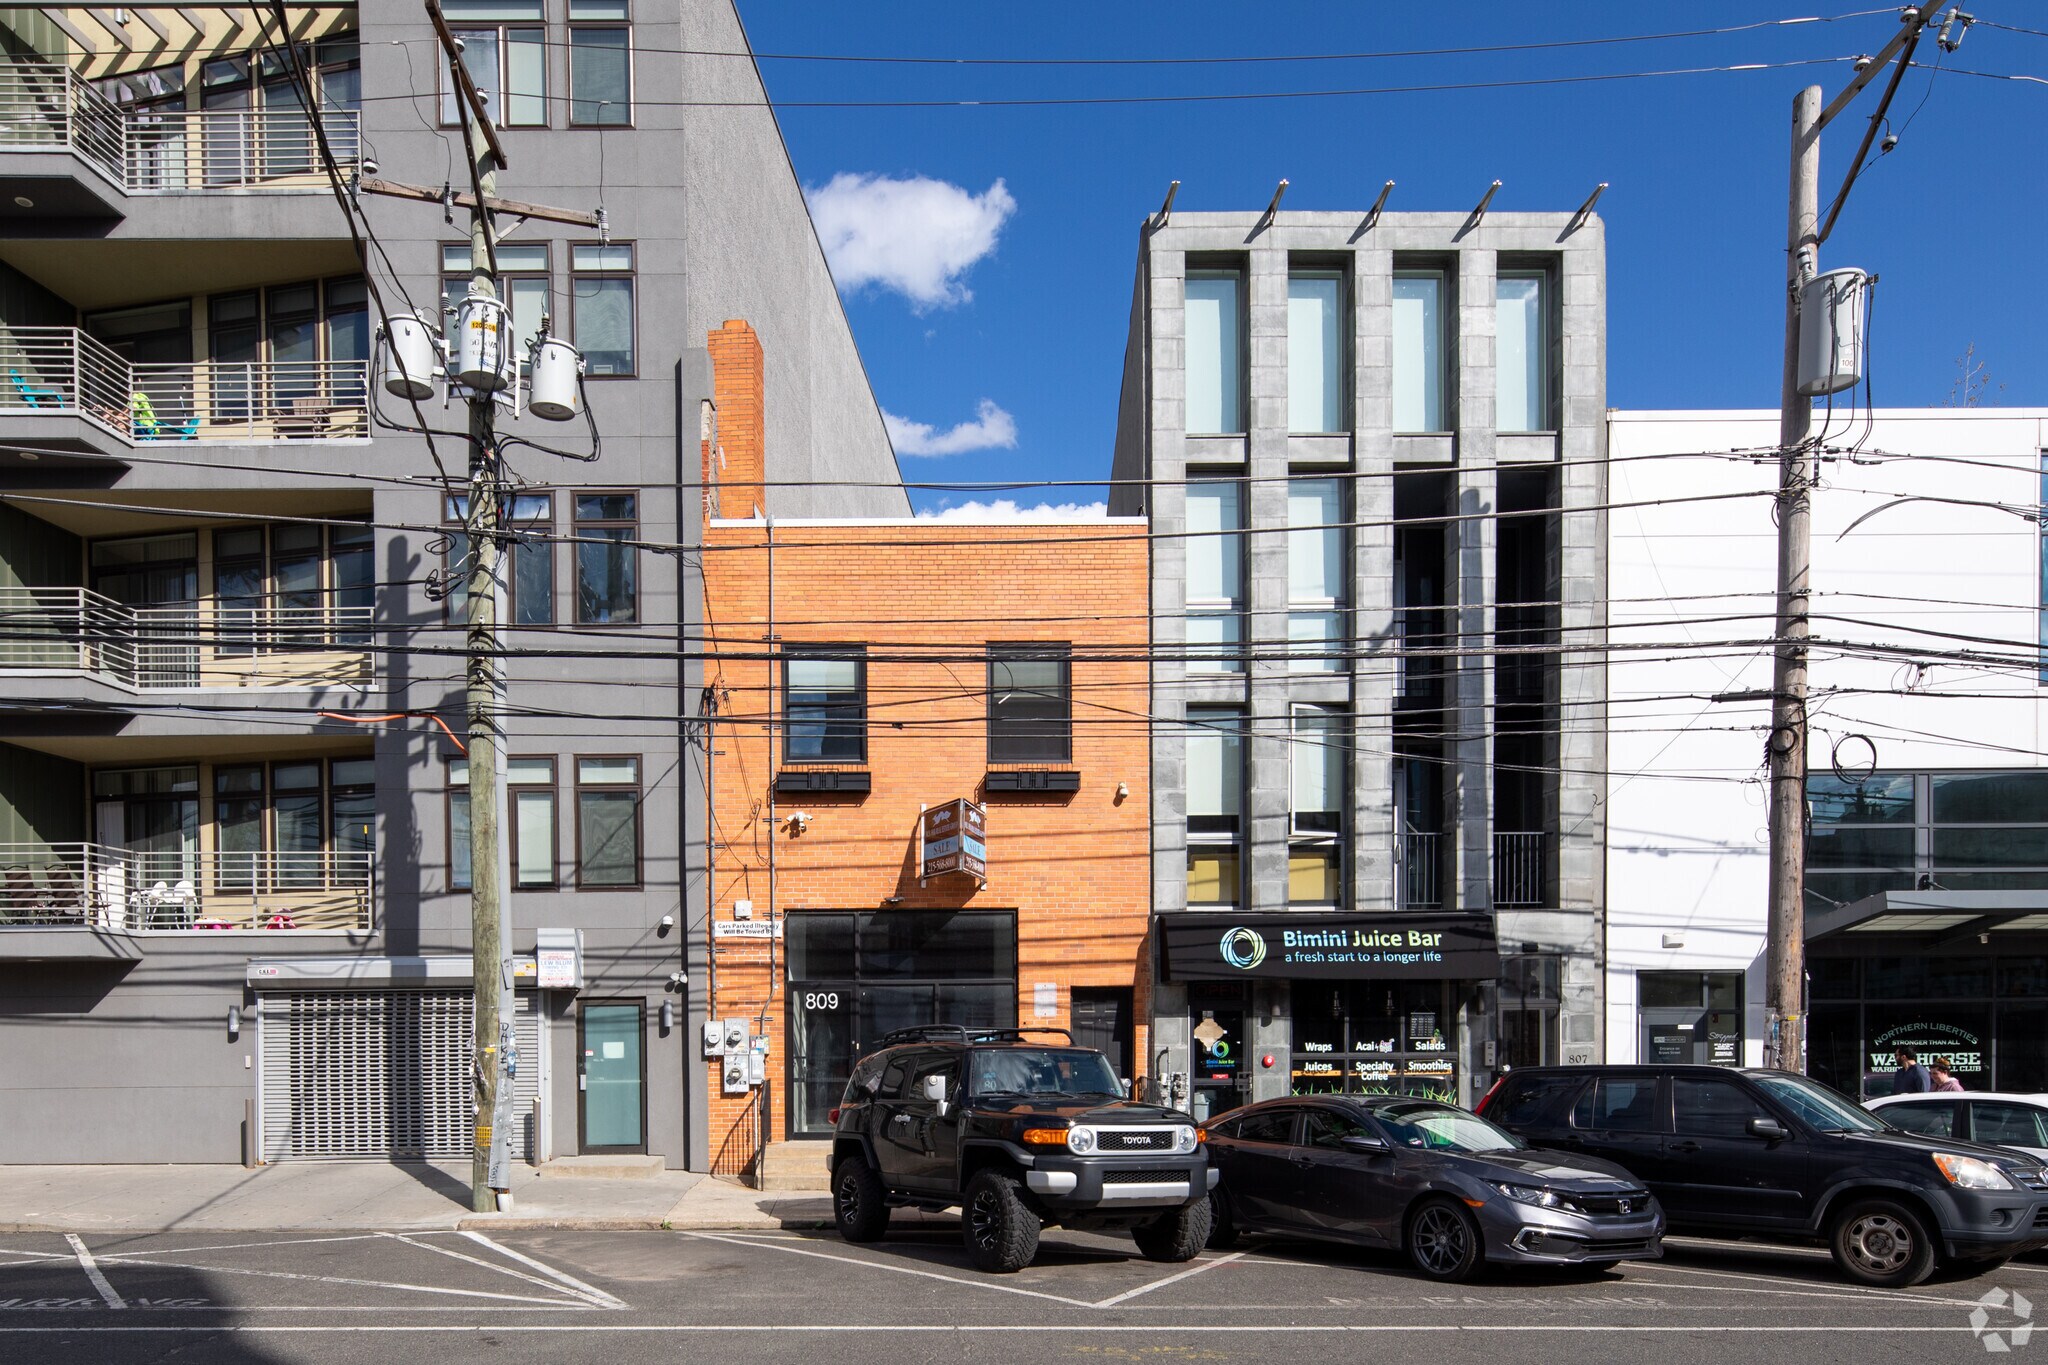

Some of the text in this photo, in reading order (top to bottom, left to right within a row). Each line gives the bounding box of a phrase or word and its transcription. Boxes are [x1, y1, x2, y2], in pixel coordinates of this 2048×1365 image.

[933, 841, 951, 855] SALE
[1283, 930, 1442, 947] Bimini Juice Bar
[1285, 951, 1442, 964] a fresh start to a longer life
[805, 992, 839, 1010] 809
[1873, 1022, 1979, 1046] NORTHERN LIBERTIES
[1305, 1042, 1332, 1053] Wraps
[1355, 1041, 1375, 1051] Acai
[1415, 1041, 1446, 1051] Salads
[1568, 1054, 1588, 1064] 807
[1870, 1052, 1981, 1066] WAHORSE
[1304, 1062, 1333, 1071] Juices
[1355, 1061, 1395, 1072] Specialty
[1408, 1061, 1453, 1071] Smoothies
[1361, 1072, 1389, 1081] Coffee
[1122, 1136, 1152, 1144] TOYOTA
